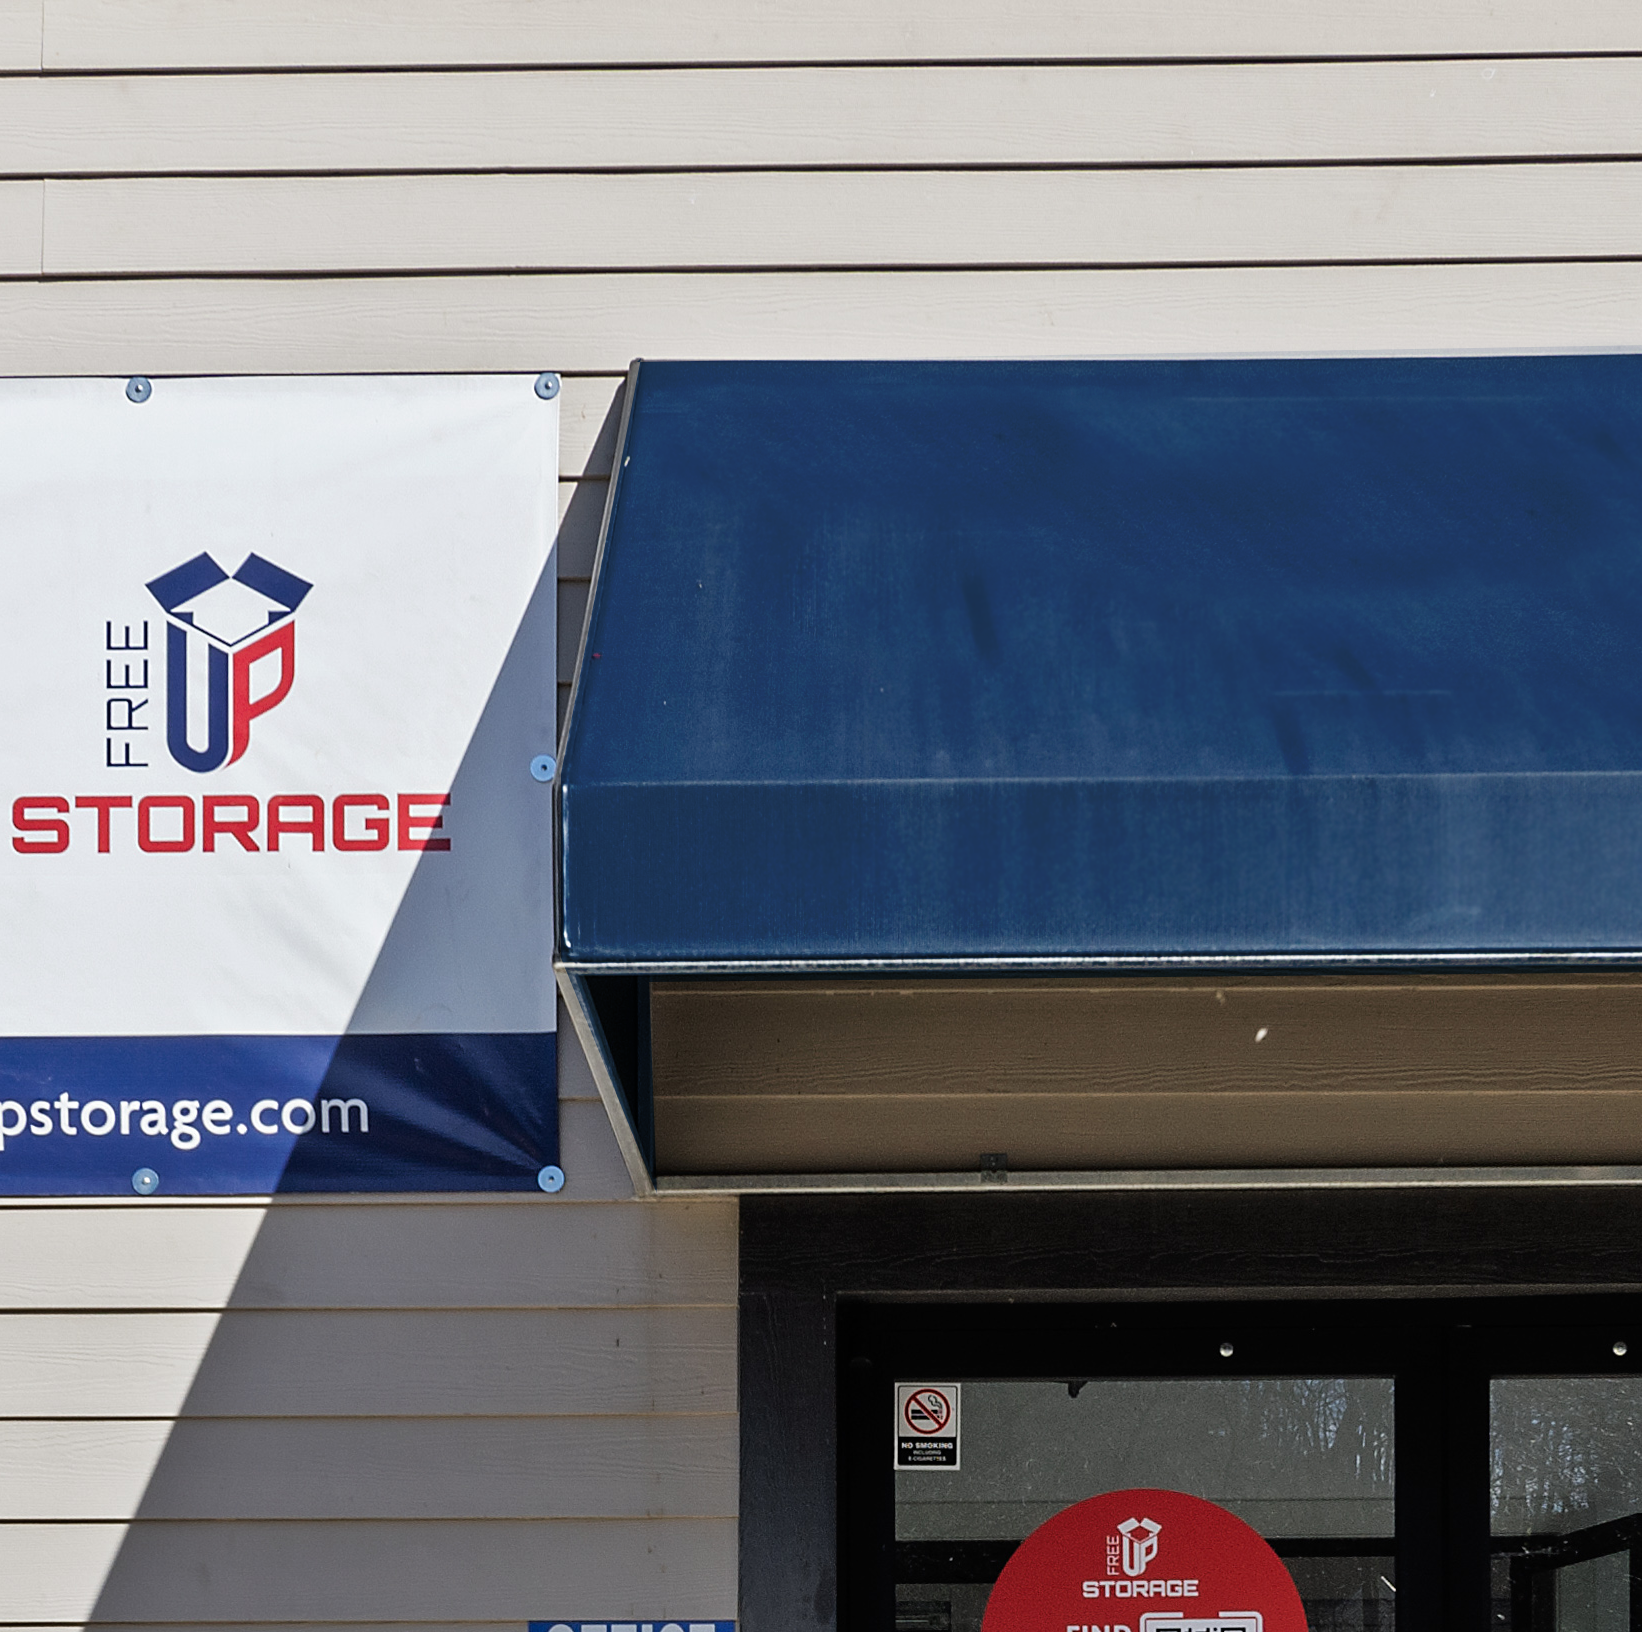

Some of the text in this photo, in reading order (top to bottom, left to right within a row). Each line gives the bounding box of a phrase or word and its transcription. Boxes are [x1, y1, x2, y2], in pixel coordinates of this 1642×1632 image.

[105, 620, 149, 768] FREE
[165, 614, 296, 774] UP
[11, 793, 452, 854] STORAGE
[1107, 1535, 1119, 1576] FREE
[1122, 1533, 1158, 1577] UP
[1082, 1580, 1199, 1598] STORAGE
